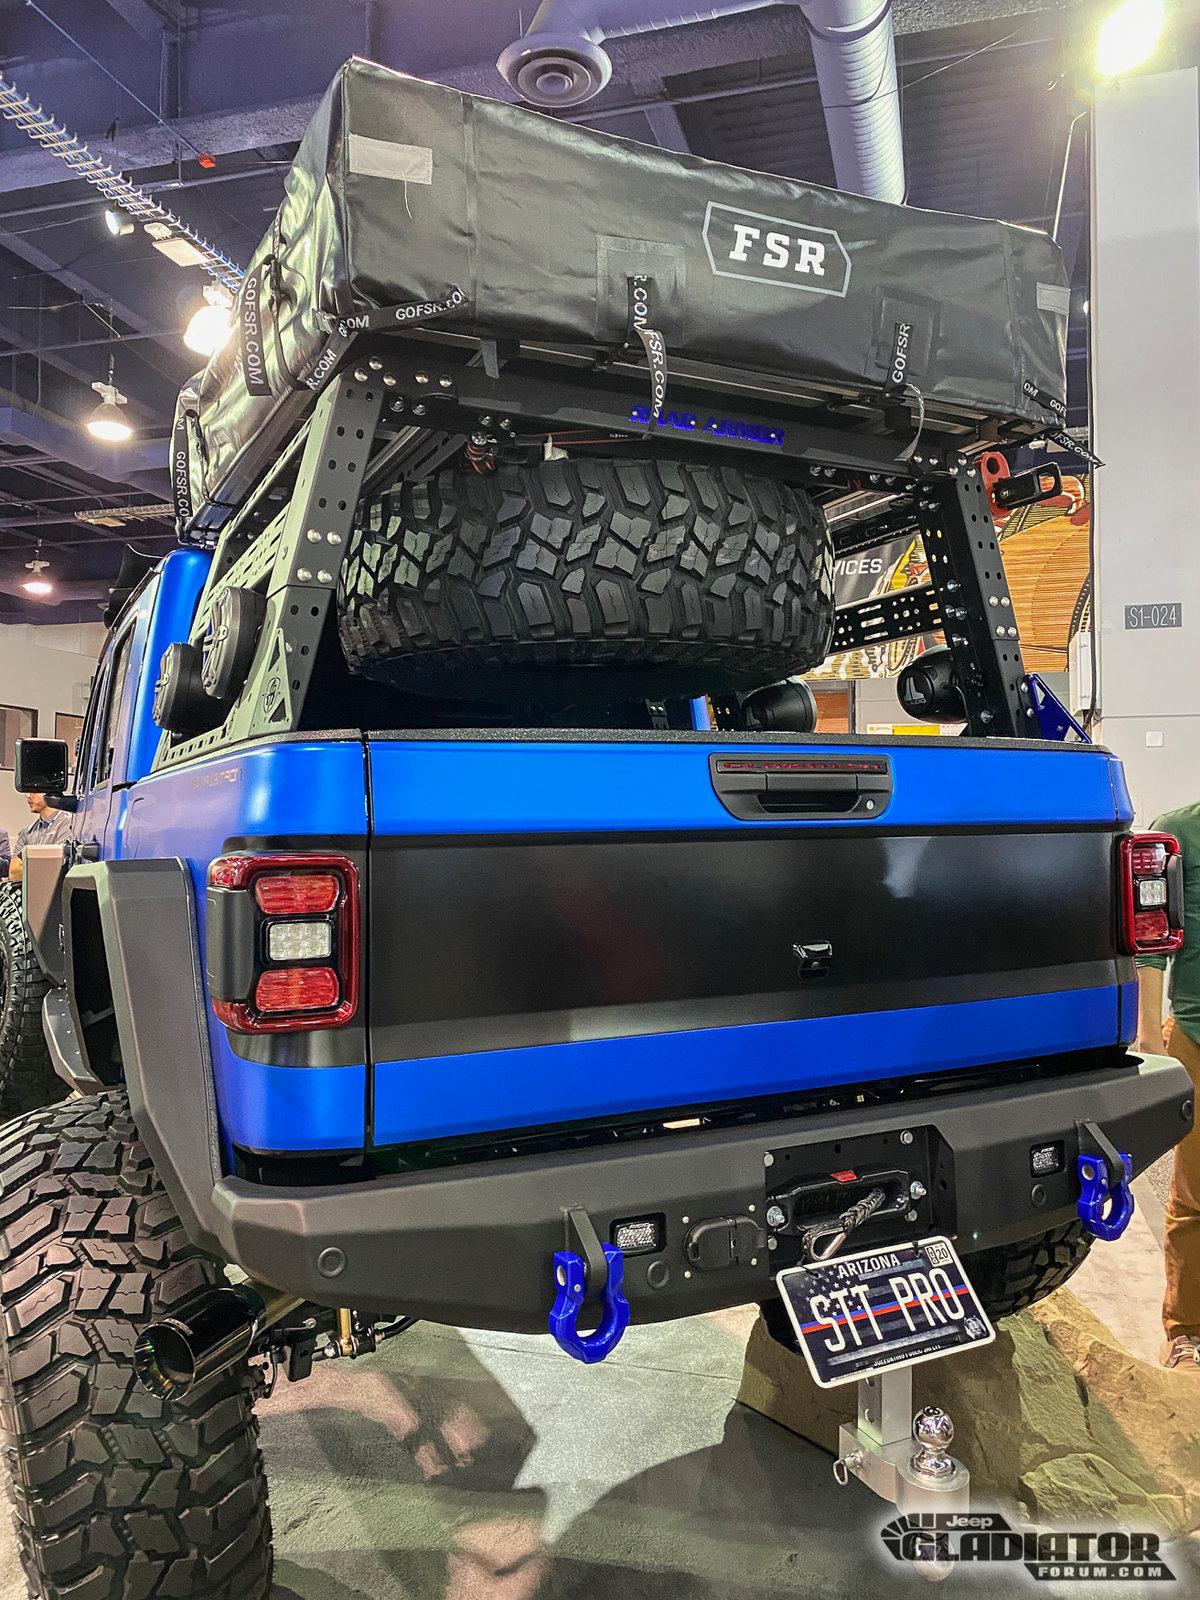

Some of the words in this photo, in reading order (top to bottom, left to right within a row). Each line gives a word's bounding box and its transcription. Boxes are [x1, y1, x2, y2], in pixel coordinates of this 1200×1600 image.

[728, 223, 827, 276] FSR
[244, 277, 265, 385] GOFSR.COM
[892, 323, 911, 384] GOFSR
[1129, 605, 1177, 628] S1-024
[837, 1252, 901, 1279] ARIZONA
[809, 1284, 884, 1353] STT
[888, 1267, 965, 1333] PRO
